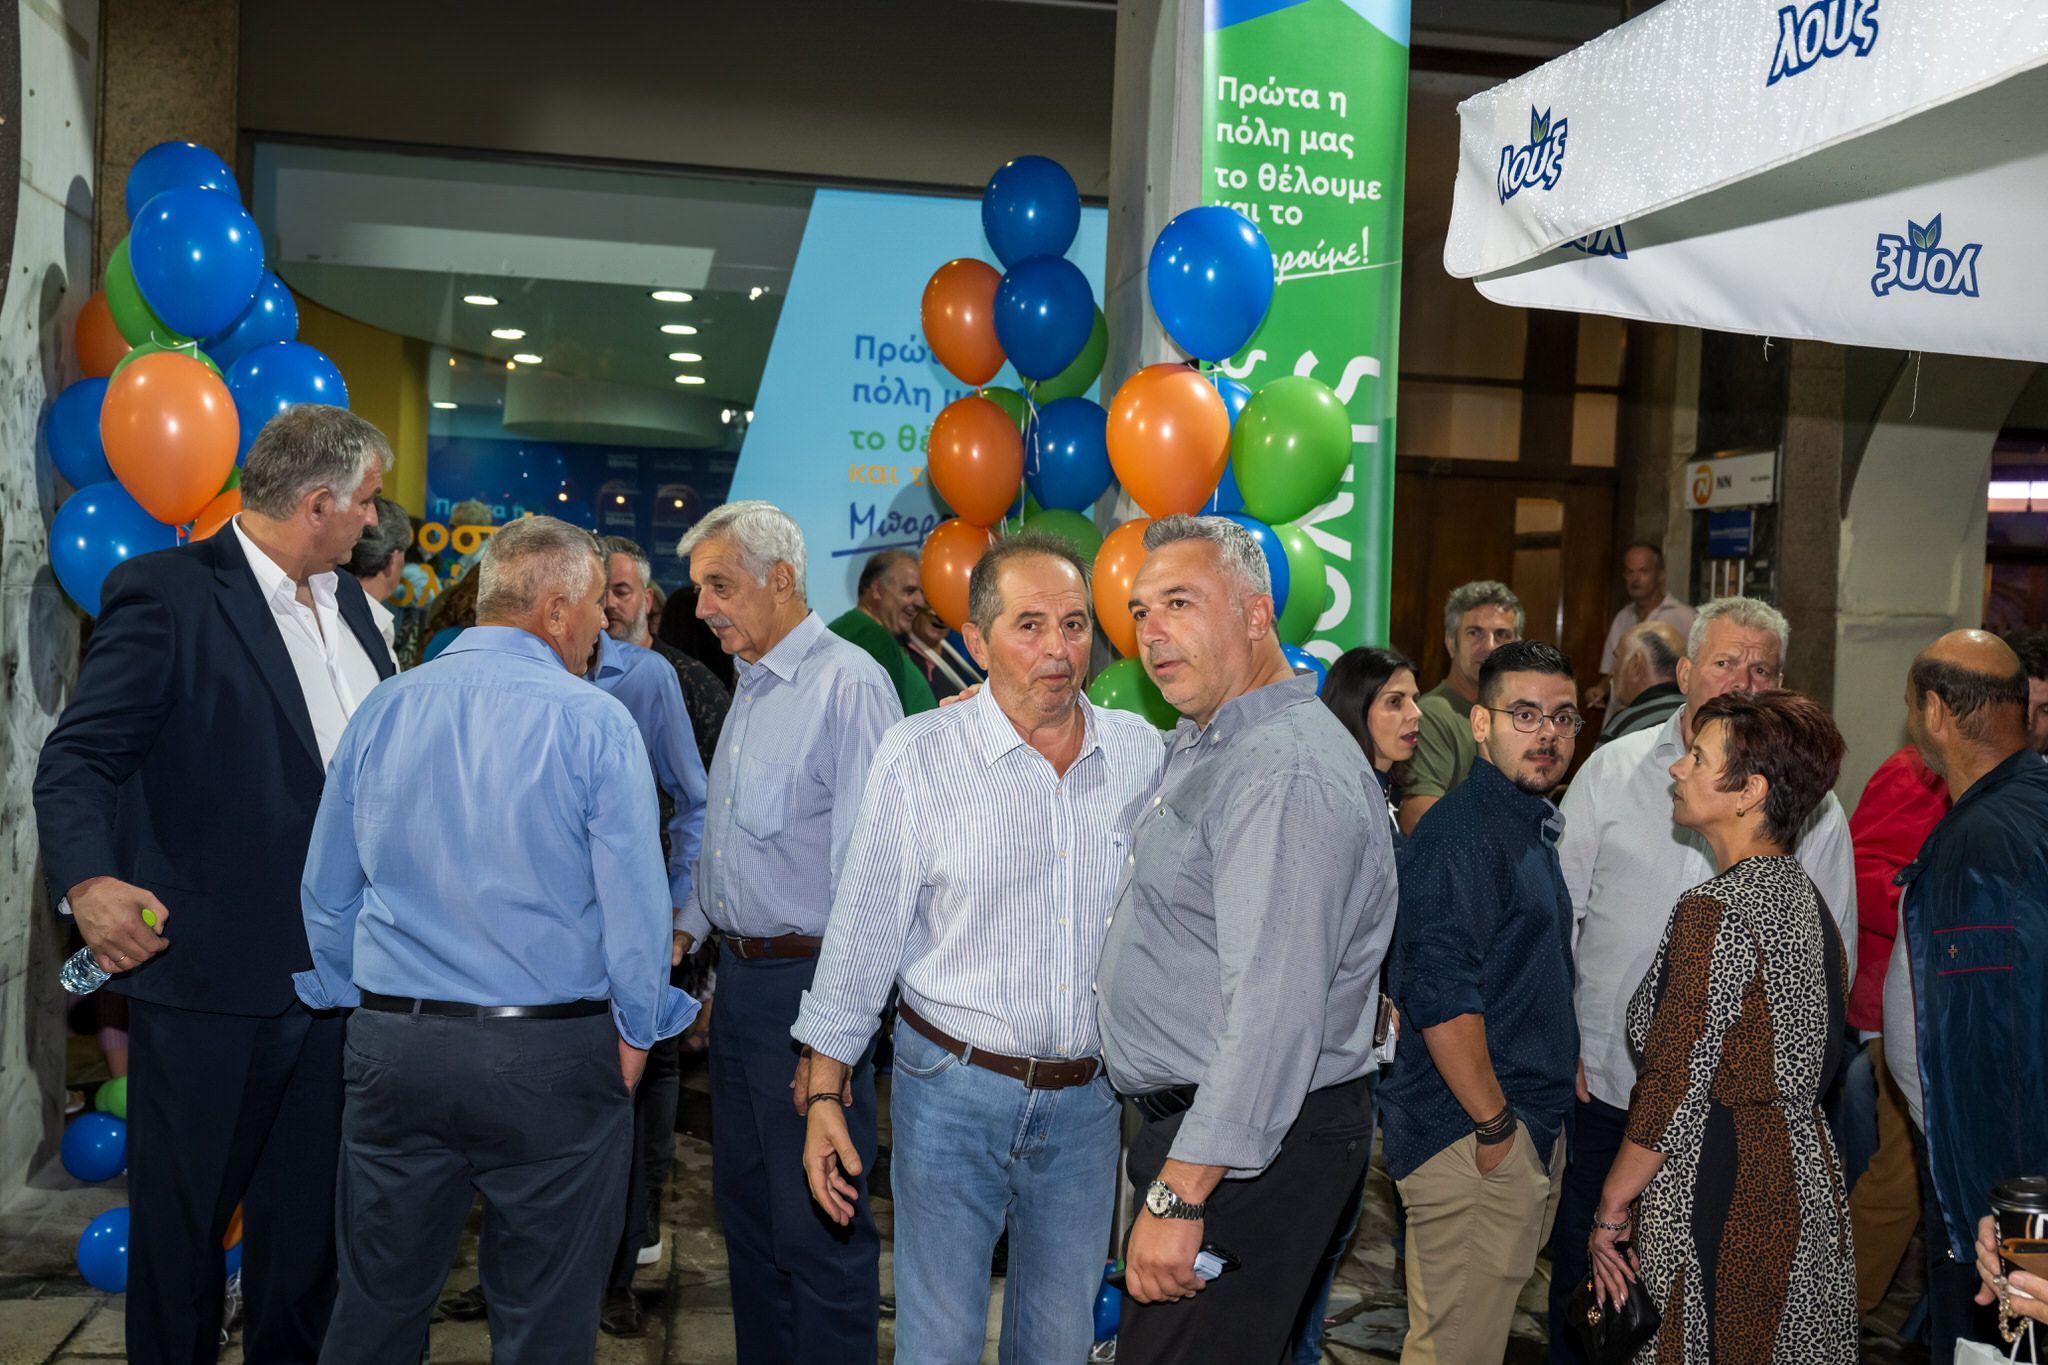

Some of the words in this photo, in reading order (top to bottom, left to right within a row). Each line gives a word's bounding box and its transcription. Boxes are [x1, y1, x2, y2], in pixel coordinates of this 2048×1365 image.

[1218, 75, 1320, 109] Πρώτα
[1328, 91, 1347, 118] η
[1216, 115, 1290, 154] πόλη
[1300, 130, 1355, 160] μας
[1214, 167, 1248, 189] το
[1257, 163, 1382, 204] θέλουμε
[1268, 204, 1303, 226] το
[854, 334, 941, 368] Πρώ
[853, 375, 931, 413] πόλη
[849, 430, 886, 451] το
[848, 463, 898, 486] και
